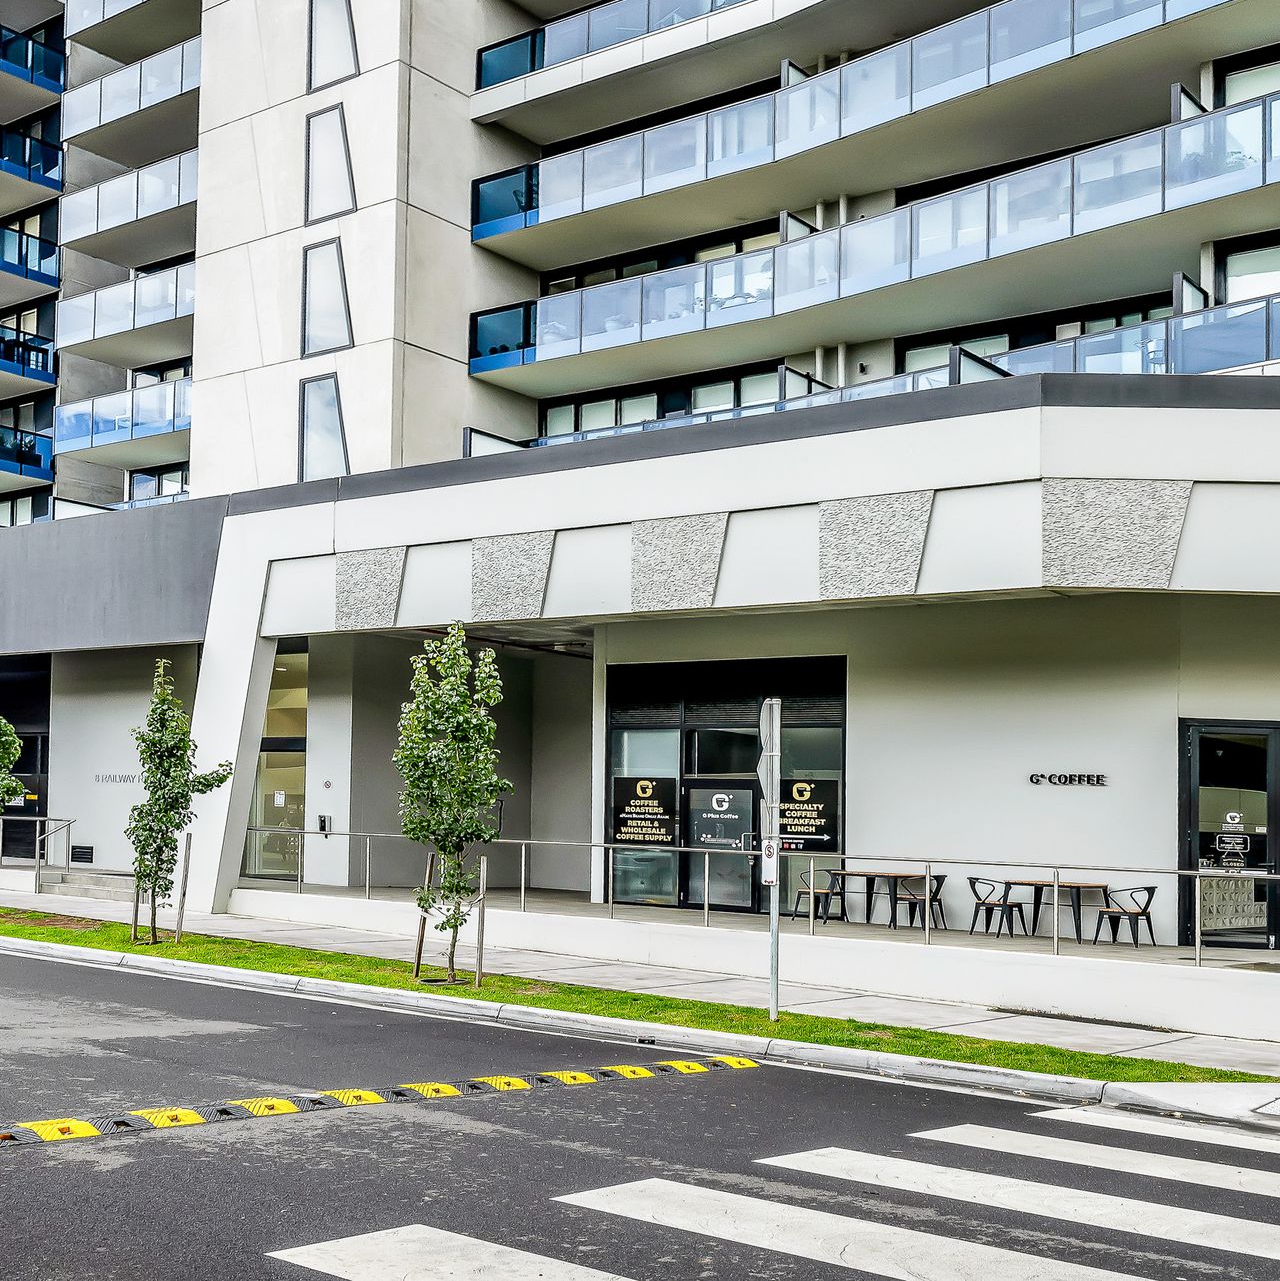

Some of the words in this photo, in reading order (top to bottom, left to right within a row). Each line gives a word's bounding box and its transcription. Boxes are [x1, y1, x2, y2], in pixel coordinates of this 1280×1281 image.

[101, 774, 137, 784] RAILWAY
[1047, 773, 1106, 786] COFFEE
[630, 799, 659, 807] COFFEE
[779, 802, 825, 811] SPECIALTY
[624, 806, 664, 814] ROASTERS
[785, 810, 818, 818] COFFEE
[778, 817, 827, 826] BREAKFAST
[620, 826, 667, 835] WHOLESALE
[787, 825, 816, 833] LUNCH
[615, 833, 644, 841] COFFEE
[644, 834, 673, 842] SUPPLY
